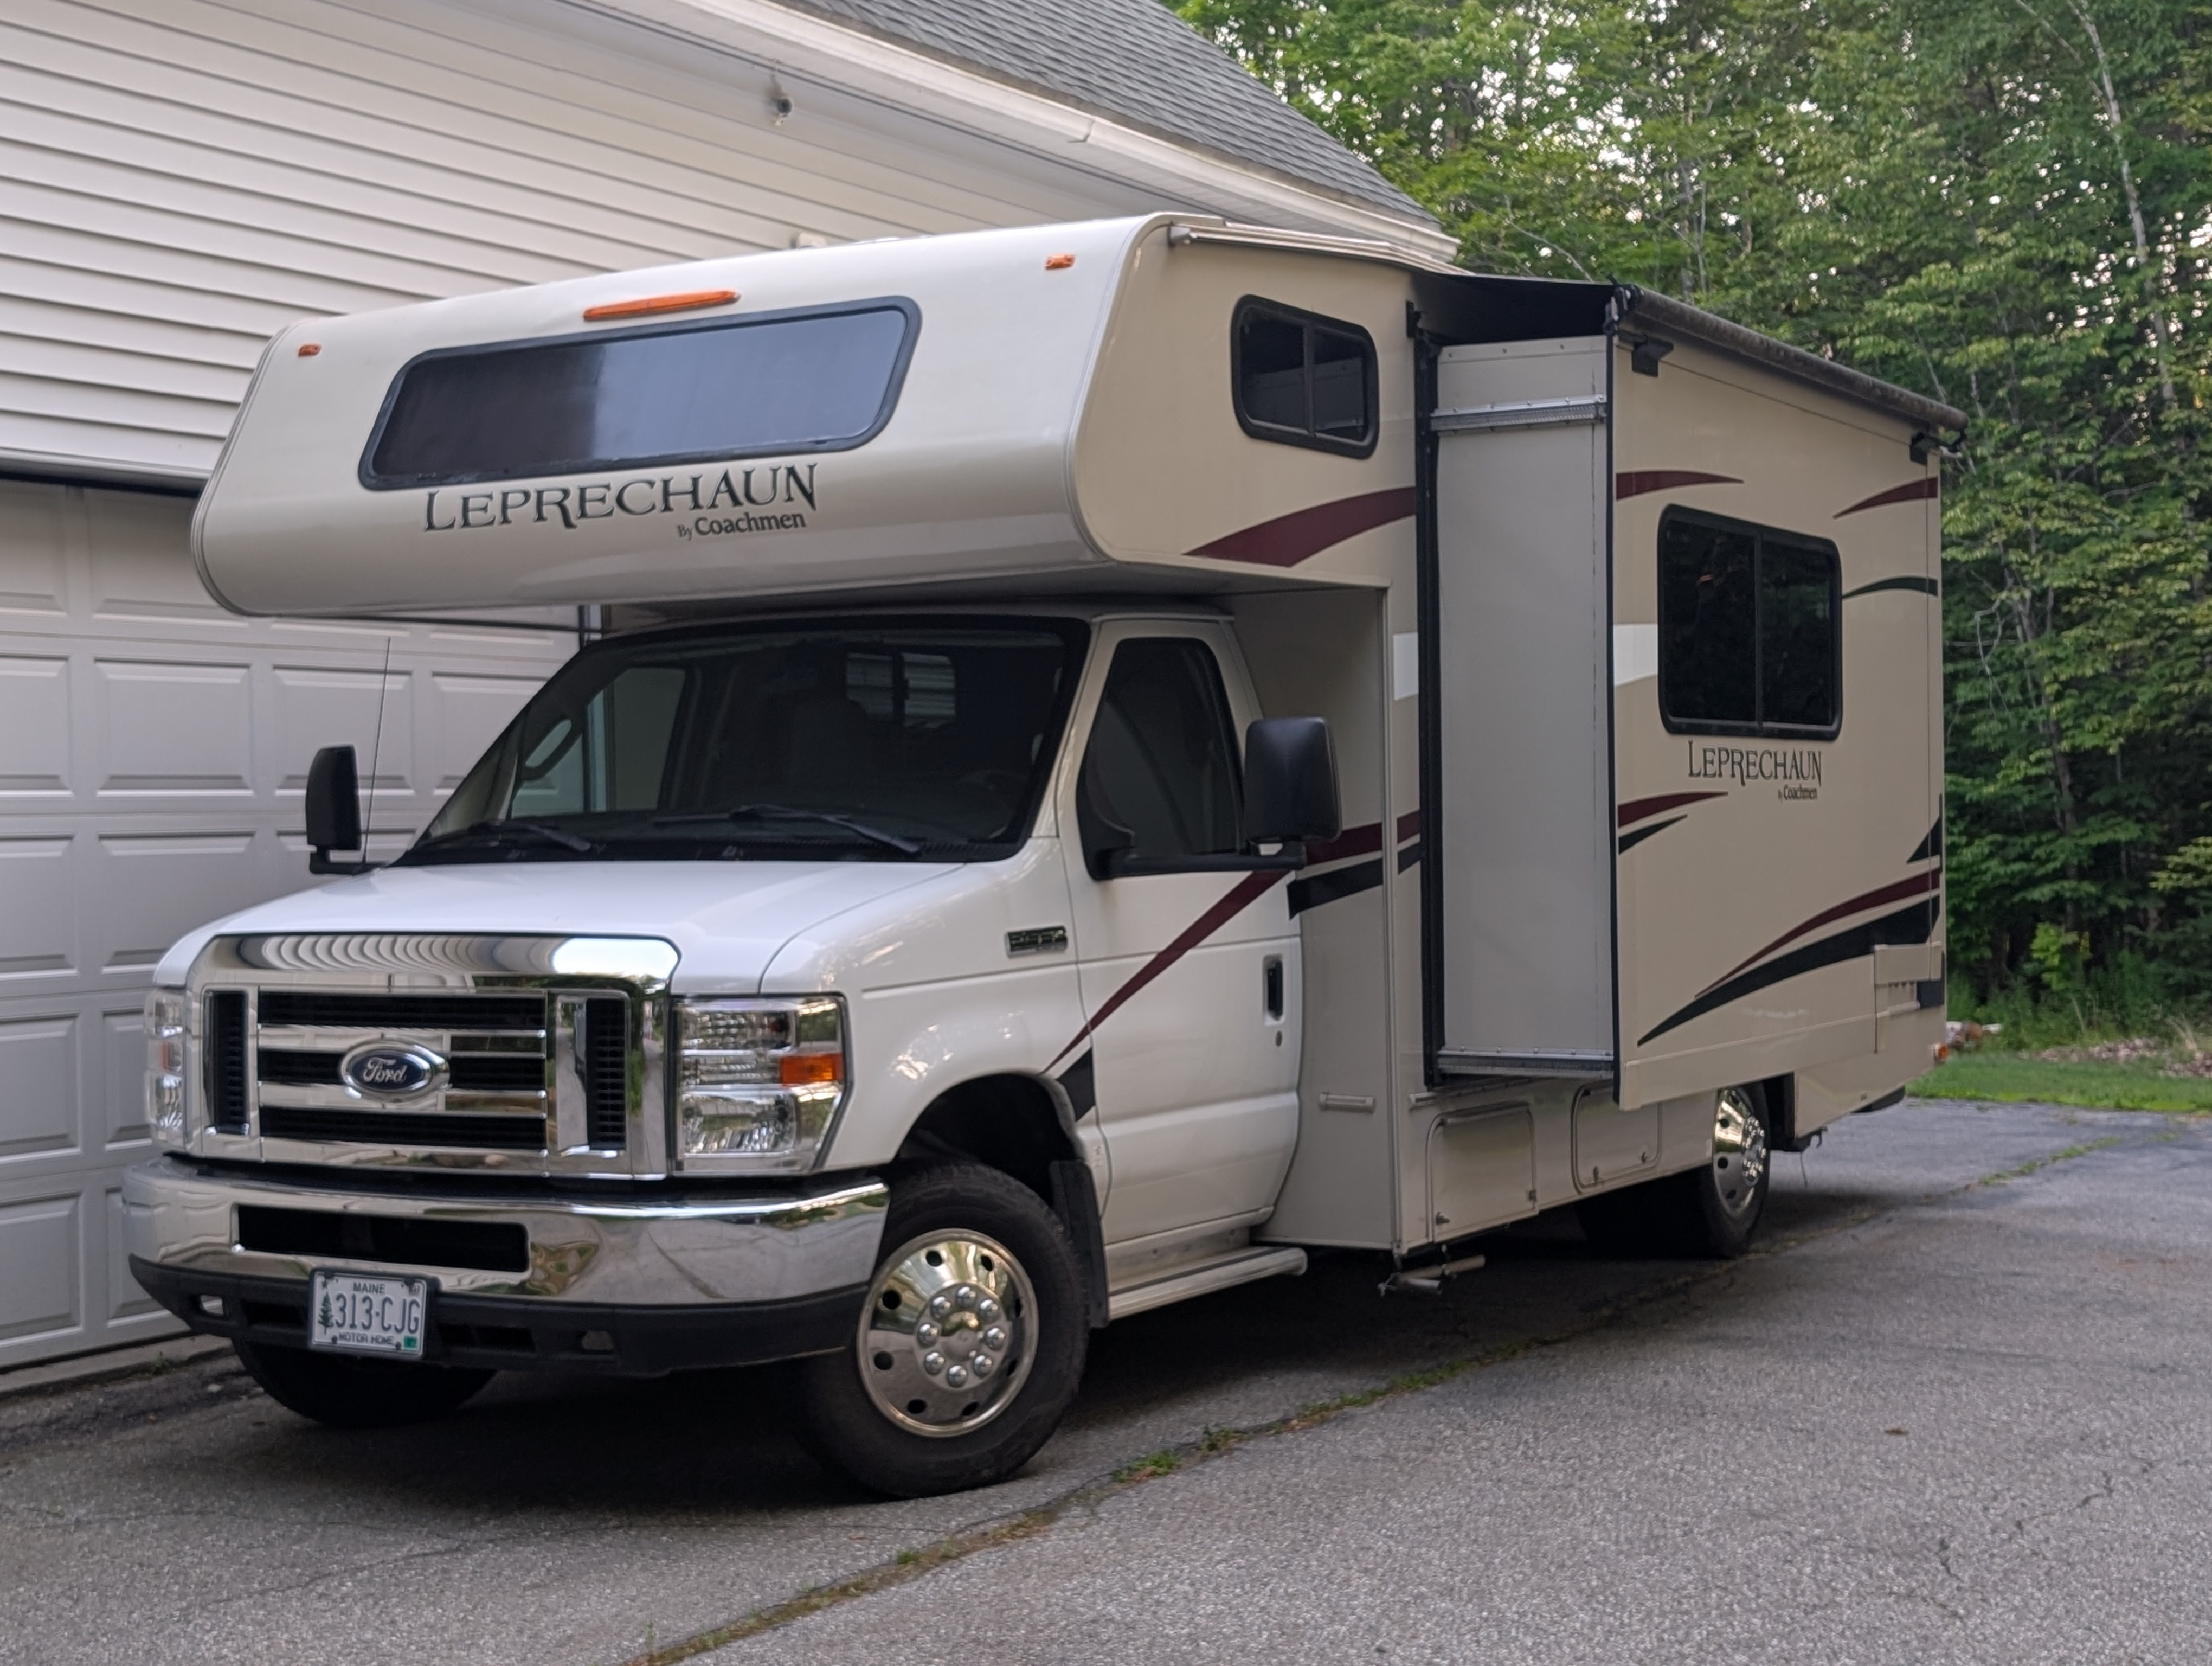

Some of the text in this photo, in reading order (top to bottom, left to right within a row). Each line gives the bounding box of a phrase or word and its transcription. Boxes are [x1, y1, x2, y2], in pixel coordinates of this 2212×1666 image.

[423, 462, 818, 532] LEPRECHAUN
[678, 512, 806, 540] By Coachmen
[1688, 739, 1822, 787] LEPRECHAUN
[363, 1057, 407, 1083] Ford
[353, 1282, 385, 1295] MAINE
